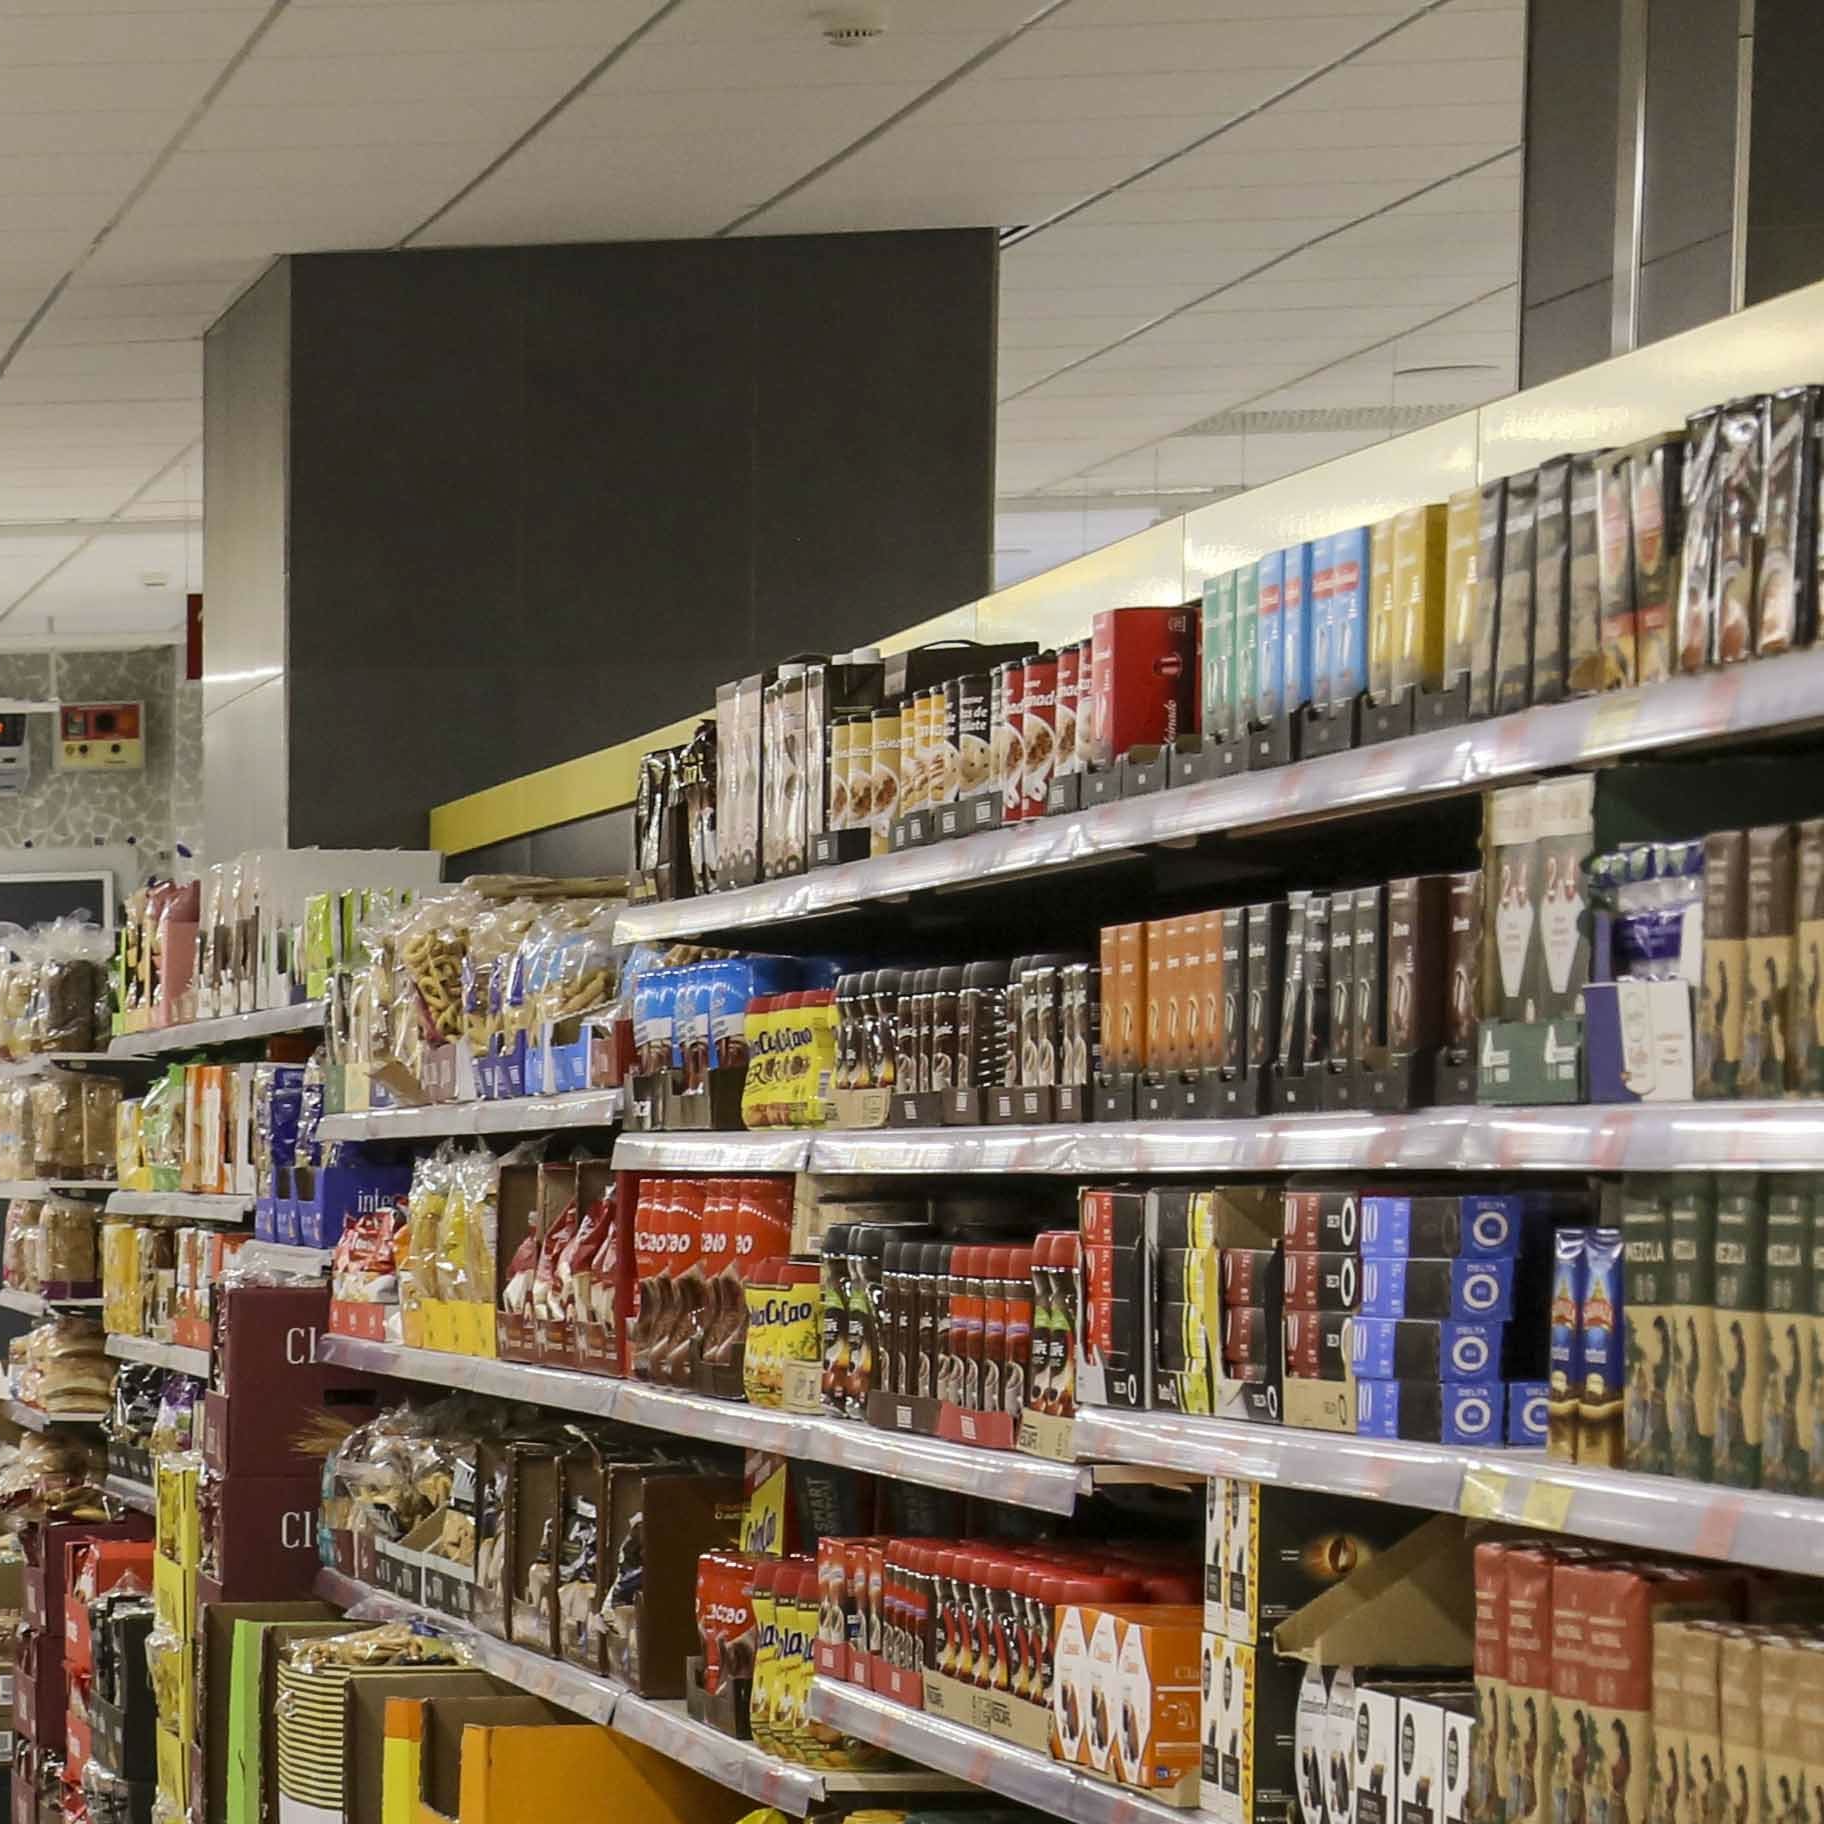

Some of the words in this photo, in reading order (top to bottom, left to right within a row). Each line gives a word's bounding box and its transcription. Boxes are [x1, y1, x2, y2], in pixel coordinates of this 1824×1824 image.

[357, 1189, 395, 1212] inte
[285, 1326, 318, 1365] Cl
[280, 1510, 313, 1549] Cl
[1173, 1666, 1201, 1681] Cla
[1242, 1656, 1253, 1807] GRATIS
